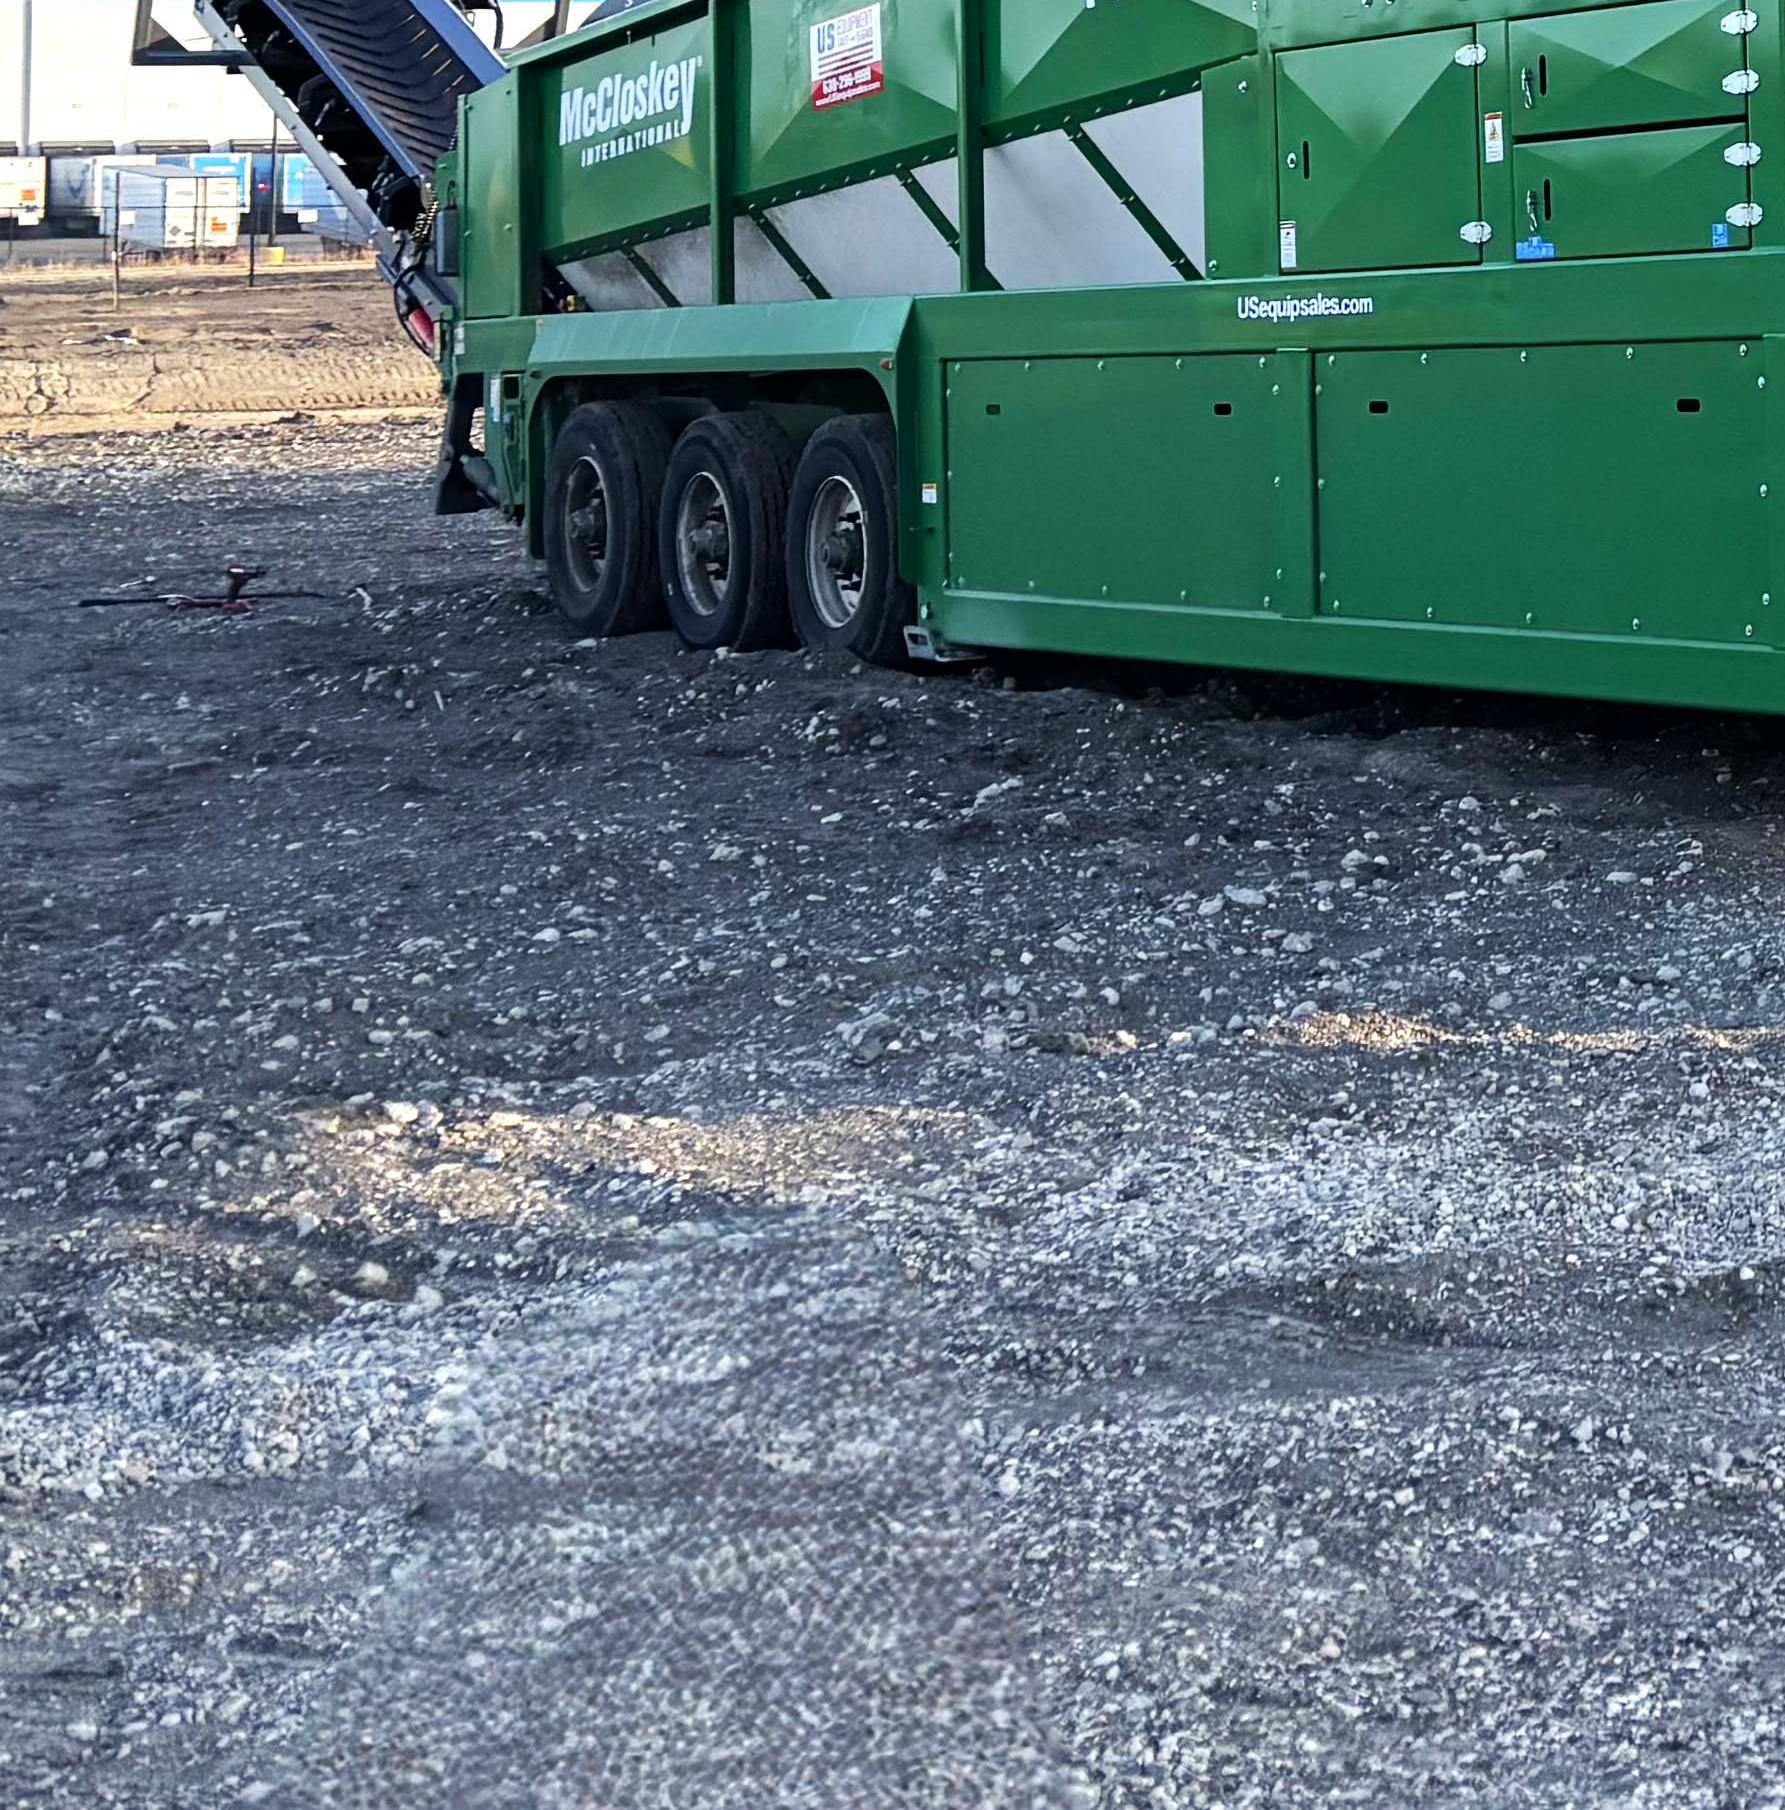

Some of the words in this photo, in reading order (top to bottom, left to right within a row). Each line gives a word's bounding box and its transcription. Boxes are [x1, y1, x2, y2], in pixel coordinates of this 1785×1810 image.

[559, 56, 697, 146] McCloskey
[581, 119, 680, 168] INTERNATIONAL
[1237, 292, 1373, 323] USequipsales.com
